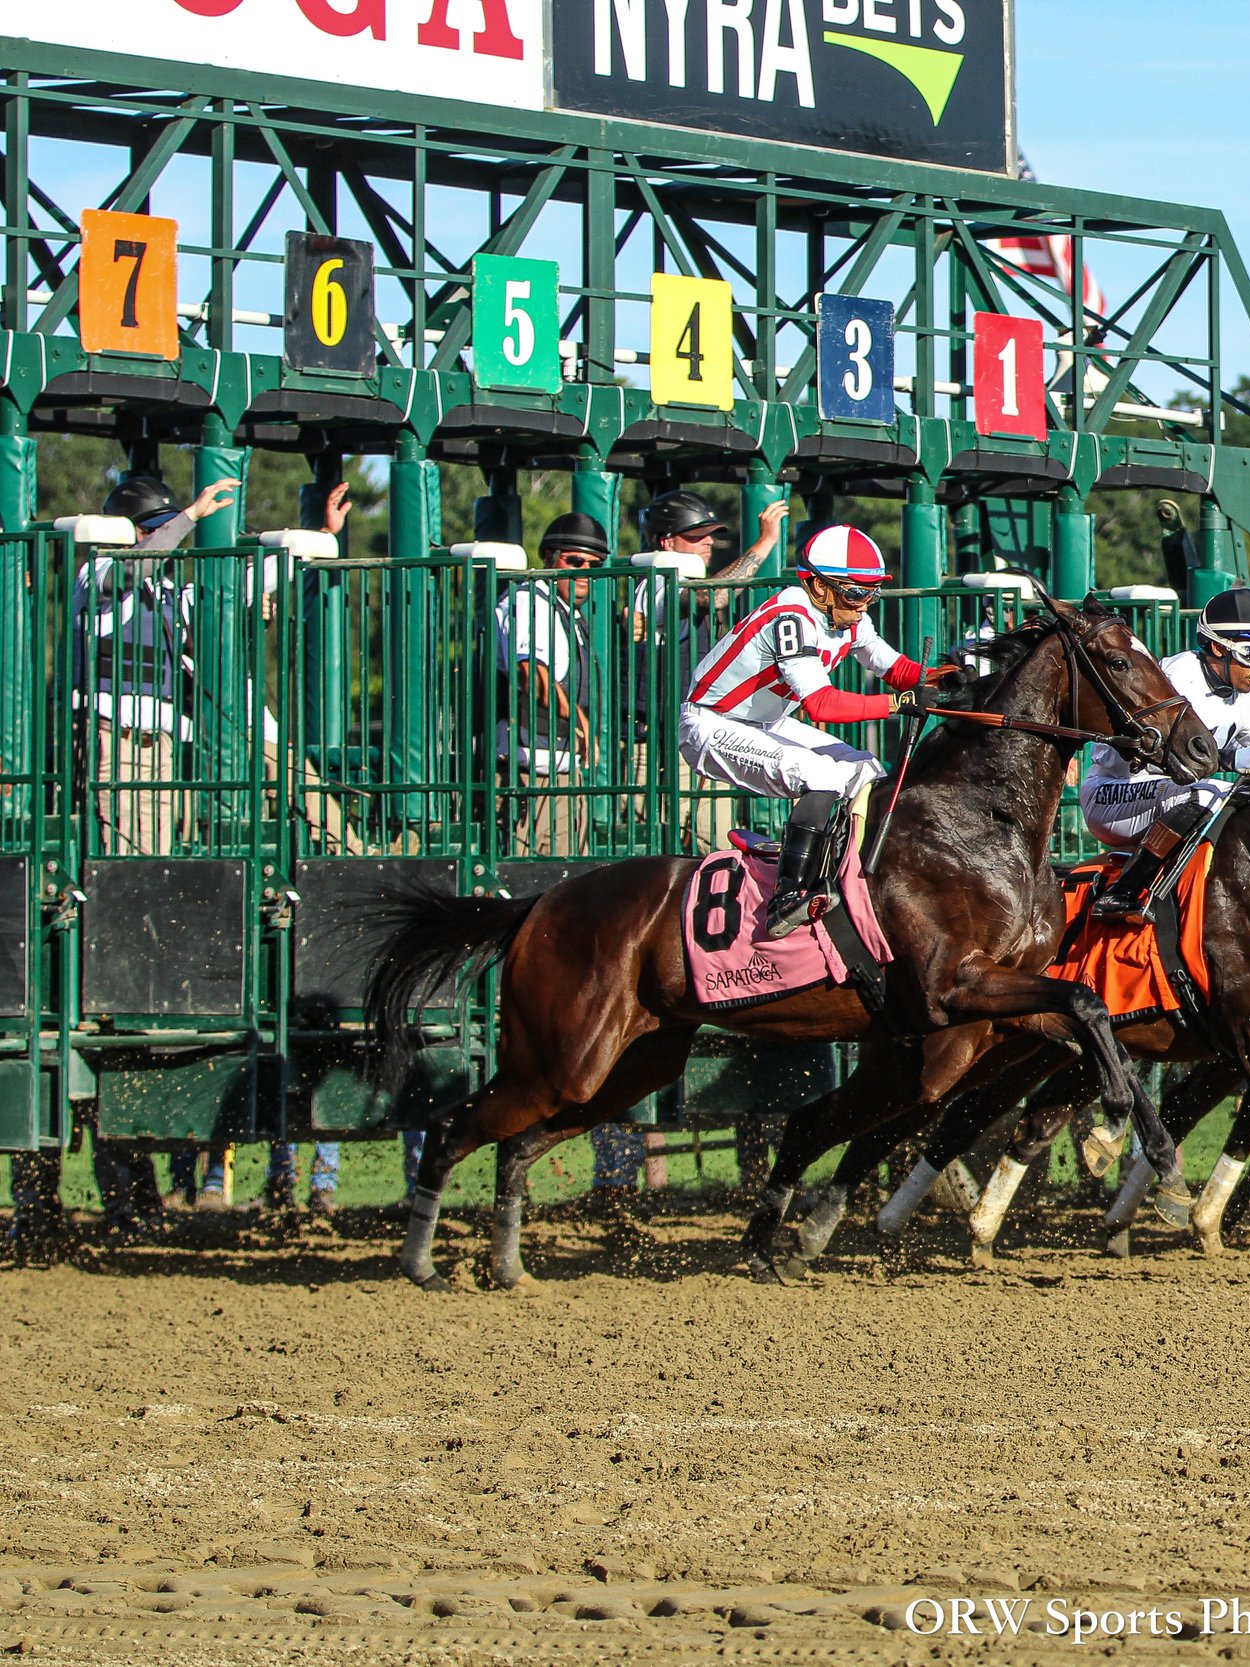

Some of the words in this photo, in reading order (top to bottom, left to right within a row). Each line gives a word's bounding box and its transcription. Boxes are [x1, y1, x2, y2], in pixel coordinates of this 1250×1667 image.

[113, 240, 147, 329] 7
[311, 258, 348, 348] 6
[502, 279, 535, 367] 5
[675, 301, 705, 382] 4
[843, 318, 873, 402] 3
[997, 337, 1020, 417] 1
[778, 620, 799, 656] 8
[1095, 779, 1159, 805] ESTATESPACE
[692, 856, 746, 953] 8
[704, 963, 783, 991] SARATOGA
